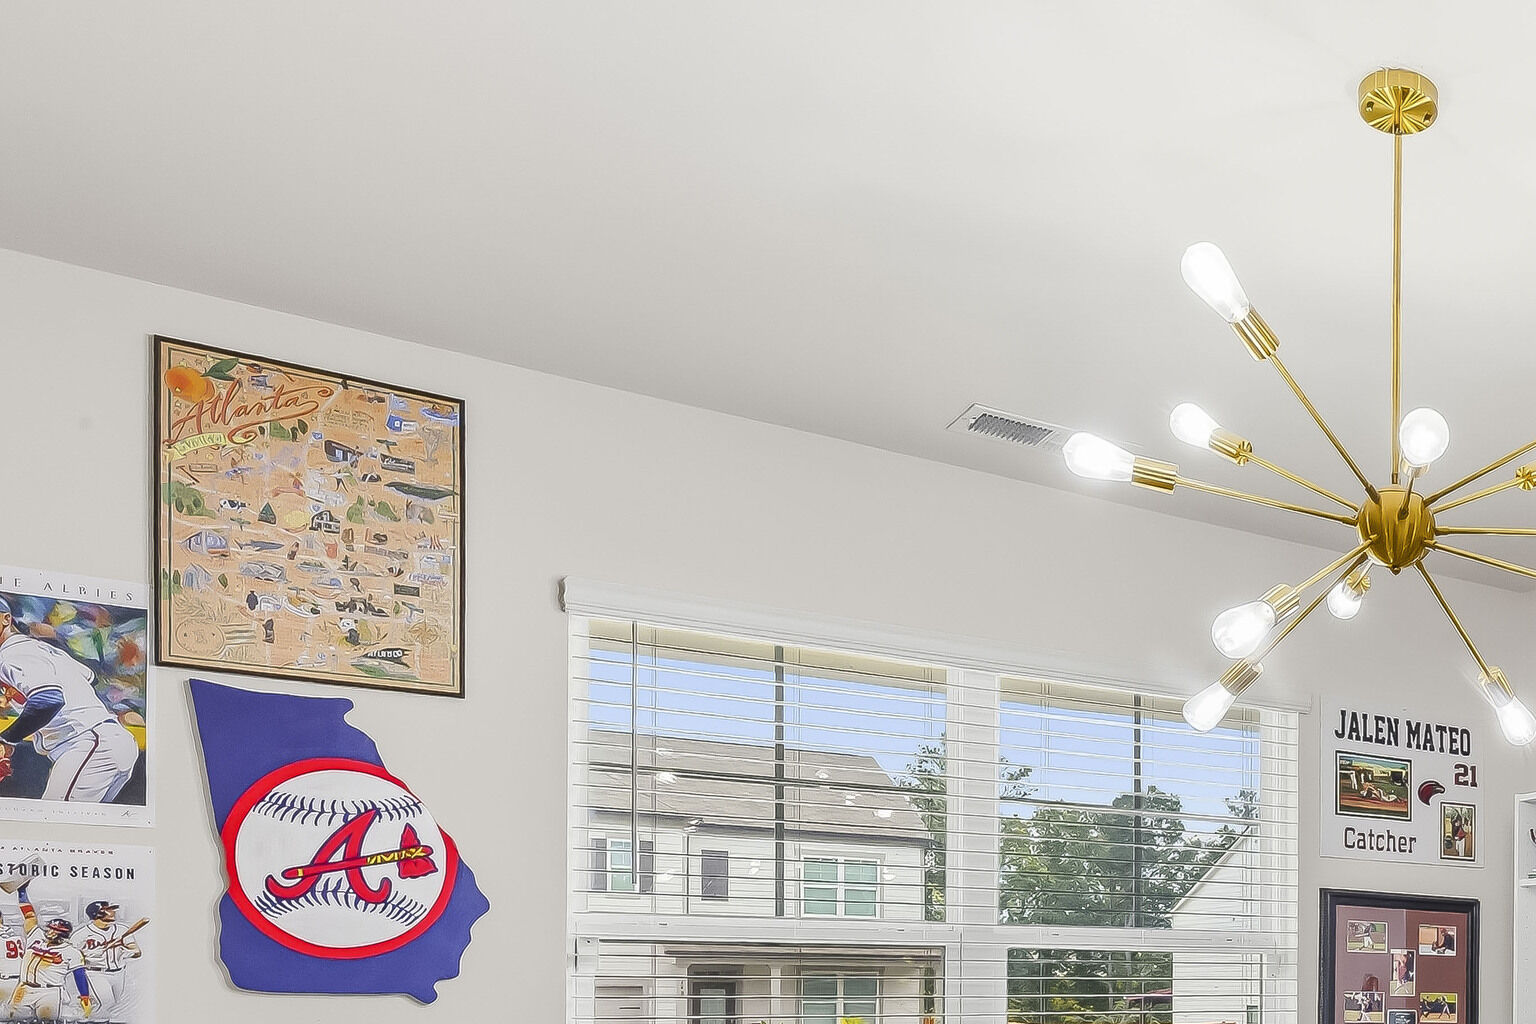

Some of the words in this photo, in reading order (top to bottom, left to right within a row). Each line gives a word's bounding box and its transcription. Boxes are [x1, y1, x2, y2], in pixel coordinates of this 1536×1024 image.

[163, 378, 334, 444] Atlanta
[1334, 709, 1400, 747] JALEN
[1405, 719, 1472, 757] MATEO
[1454, 763, 1478, 787] 21
[1343, 826, 1416, 853] Catcher
[69, 865, 135, 880] SEASON
